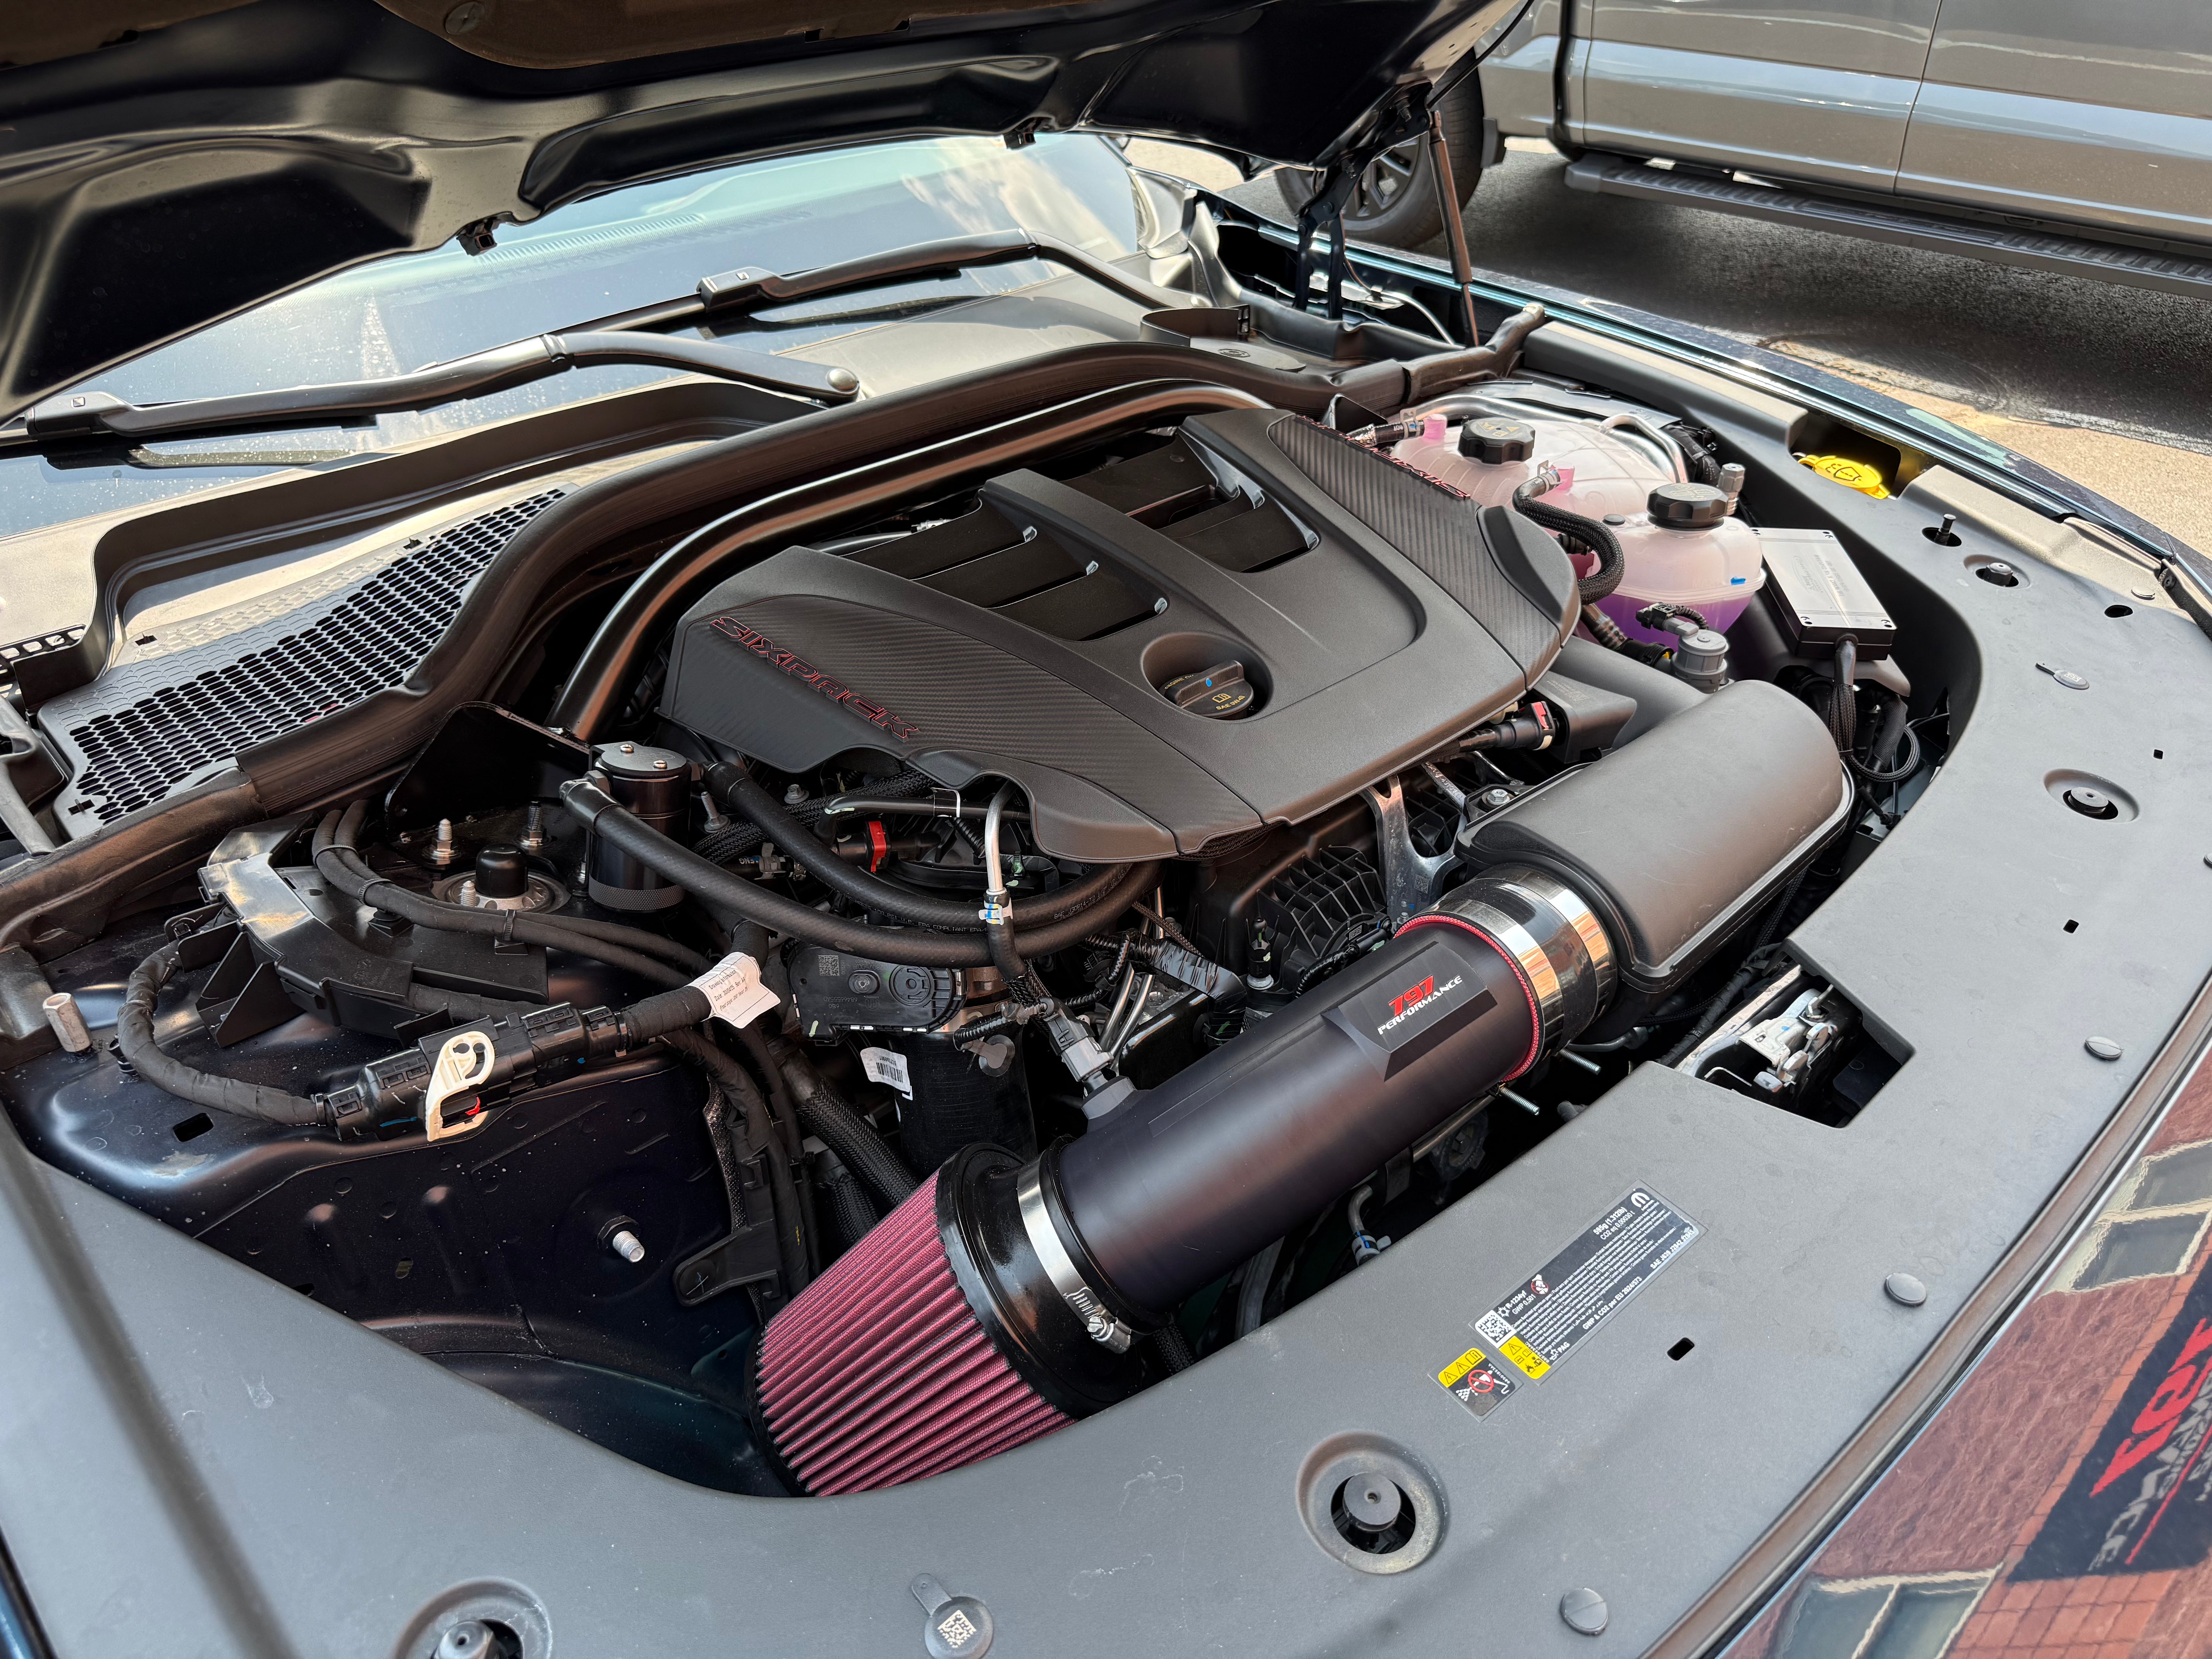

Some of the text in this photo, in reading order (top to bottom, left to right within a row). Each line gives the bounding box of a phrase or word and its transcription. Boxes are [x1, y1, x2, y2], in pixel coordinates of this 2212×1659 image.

[709, 617, 921, 743] SIXPACK
[1164, 678, 1184, 689] ENGINE
[1377, 975, 1462, 1035] PERFORMANCE
[1389, 975, 1434, 1017] 797
[1592, 1206, 1628, 1236] 595g (1.312lb)
[1600, 1230, 1613, 1240] CO2
[1649, 1257, 1663, 1269] SAE
[1504, 1289, 1528, 1310] R-1234yf
[1511, 1293, 1537, 1315] GWP 0,501
[1581, 1317, 1597, 1331] GWP
[1597, 1305, 1610, 1316] CO2
[1607, 1298, 1619, 1308] per
[1614, 1291, 1625, 1301] EU
[1621, 1275, 1643, 1295] 2024/573
[1556, 1341, 1571, 1353] PAG
